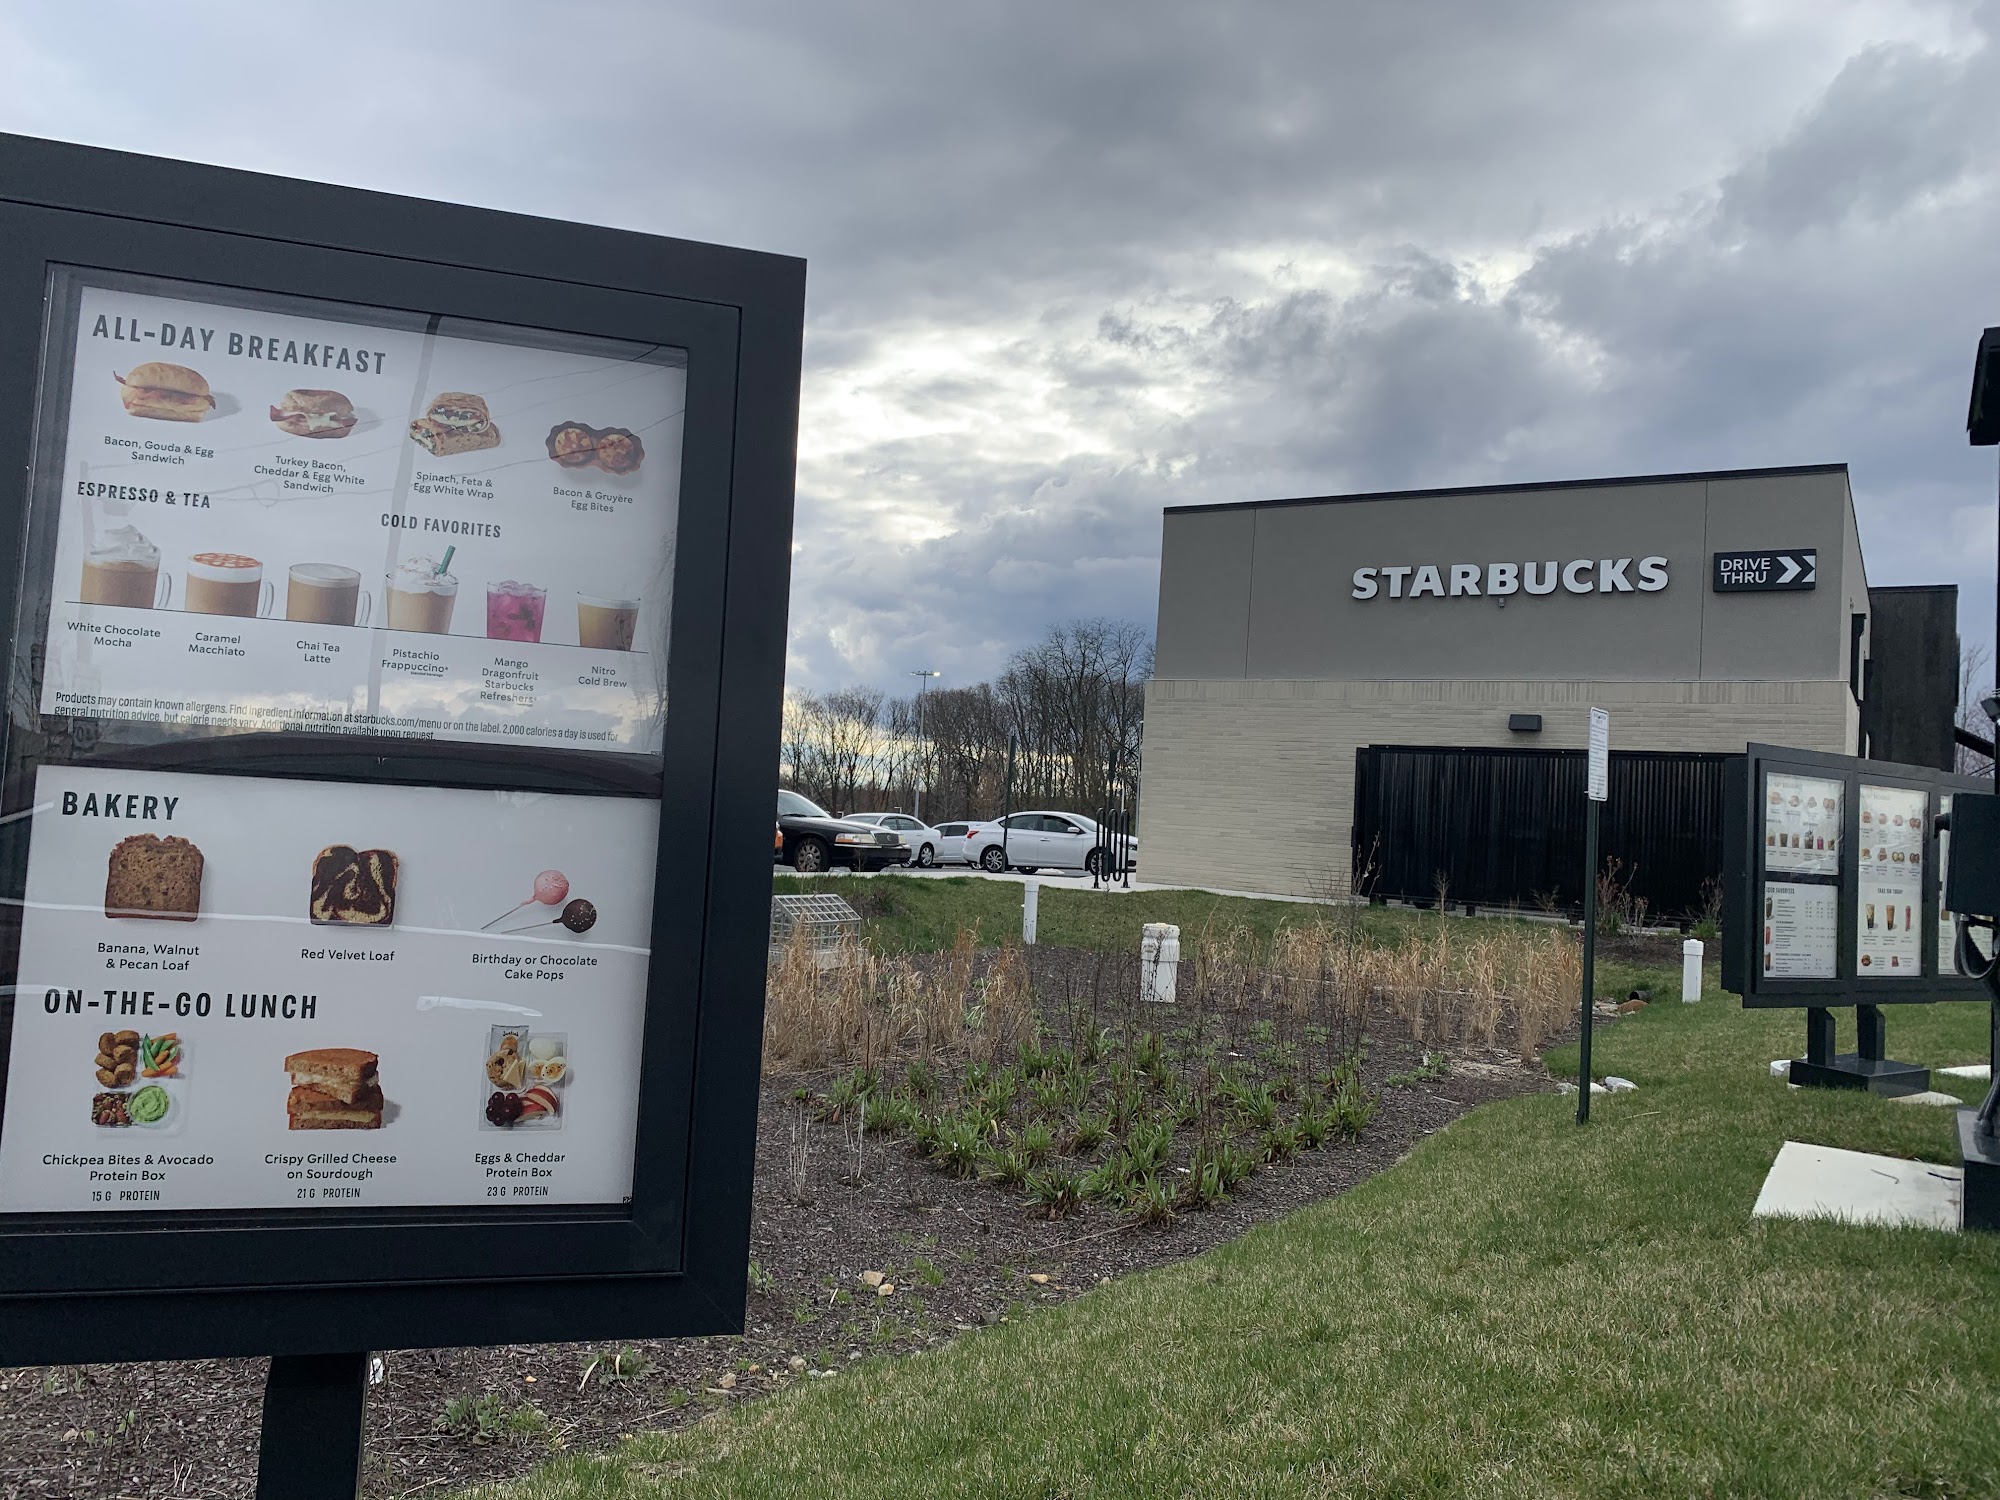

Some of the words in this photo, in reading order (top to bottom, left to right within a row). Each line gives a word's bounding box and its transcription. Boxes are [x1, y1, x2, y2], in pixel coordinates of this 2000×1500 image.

[92, 314, 215, 351] ALL-DAY
[228, 332, 386, 374] BREAKFAST
[104, 436, 141, 450] Bacon,
[144, 440, 181, 453] Gouda
[183, 445, 194, 455] &
[196, 446, 214, 459] Egg
[131, 450, 185, 465] Sandwich
[275, 455, 309, 470] Turkey
[311, 458, 347, 473] Bacon,
[254, 465, 299, 478] Cheddar
[302, 470, 311, 479] &
[313, 470, 331, 484] Egg
[334, 472, 365, 485] White
[416, 472, 459, 485] Spinach,
[461, 476, 483, 487] Feta
[485, 479, 493, 488] &
[283, 480, 334, 494] Sandwich
[414, 482, 431, 494] Egg
[433, 484, 464, 496] White
[467, 488, 494, 500] Wrap
[553, 487, 583, 498] Bacon
[586, 490, 593, 499] &
[77, 481, 158, 503] ESPRESSO
[165, 491, 177, 504] &
[183, 493, 211, 509] TEA
[571, 500, 588, 512] Egg
[590, 502, 614, 513] Bites
[381, 514, 418, 530] COLD
[424, 518, 501, 538] FAVORITES
[1720, 557, 1771, 572] DRIVE
[1351, 556, 1669, 600] STARBUCKS
[1720, 570, 1767, 585] THRU
[67, 622, 102, 633] White
[104, 624, 161, 638] Chocolate
[94, 637, 132, 648] Mocha
[195, 632, 241, 644] Caramel
[188, 644, 245, 657] Macchiato
[296, 640, 321, 651] Chai
[323, 642, 340, 653] Tea
[304, 653, 331, 664] Latte
[393, 648, 440, 661] Pistachio
[494, 658, 528, 669] Mango
[482, 668, 539, 681] Dragonfruit
[592, 665, 616, 677] Nitro
[485, 680, 534, 692] Starbucks
[578, 676, 600, 687] Cold
[602, 678, 627, 689] Brew
[55, 706, 88, 716] general
[90, 708, 129, 719] nutrition
[164, 712, 179, 723] but
[181, 714, 209, 725] calorie
[212, 716, 238, 727] needs
[261, 720, 302, 731] Additional
[304, 722, 341, 734] nutrition
[343, 726, 379, 736] available
[380, 730, 401, 738] upon
[56, 692, 96, 705] Products
[98, 697, 117, 708] may
[119, 697, 152, 709] contain
[155, 699, 184, 711] known
[186, 701, 227, 714] allergens.
[230, 704, 247, 715] Find
[250, 706, 292, 718] ingredient
[294, 709, 342, 722] information
[344, 714, 352, 722] at
[354, 714, 442, 729] starbucks.com/menu
[454, 722, 463, 730] on
[466, 722, 478, 732] the
[480, 722, 500, 733] label.
[503, 724, 525, 735] 2,000
[526, 727, 557, 738] calories
[558, 730, 563, 738] a
[564, 729, 579, 741] day
[580, 730, 587, 739] is
[588, 731, 606, 741] used
[608, 732, 618, 742] for
[61, 791, 179, 821] BAKERY
[98, 942, 150, 956] Banana,
[154, 944, 200, 956] Walnut
[301, 949, 325, 961] Red
[328, 950, 366, 961] Velvet
[370, 950, 395, 962] Loaf
[106, 959, 115, 969] &
[120, 959, 158, 970] Pecan
[162, 960, 190, 971] Loaf
[472, 954, 522, 967] Birthday
[525, 957, 537, 966] or
[540, 955, 598, 966] Chocolate
[504, 968, 533, 980] Cake
[536, 970, 564, 982] Pops
[44, 989, 212, 1016] ON-THE-GO
[225, 993, 317, 1019] LUNCH
[42, 1154, 104, 1167] Chickpea
[108, 1154, 141, 1165] Bites
[144, 1154, 154, 1165] &
[158, 1154, 214, 1165] Avocado
[265, 1154, 304, 1167] Crispy
[307, 1152, 349, 1165] Grilled
[352, 1153, 397, 1165] Cheese
[475, 1152, 501, 1165] Eggs
[504, 1153, 513, 1163] &
[514, 1152, 565, 1164] Cheddar
[90, 1170, 137, 1181] Protein
[142, 1170, 166, 1181] Box
[287, 1170, 303, 1179] on
[306, 1168, 373, 1181] Sourdough
[486, 1167, 528, 1178] Protein
[532, 1167, 553, 1178] Box
[92, 1191, 102, 1201] 15
[105, 1191, 111, 1201] G
[120, 1190, 160, 1201] PROTEIN
[297, 1188, 307, 1199] 21
[309, 1188, 316, 1199] G
[323, 1188, 361, 1199] PROTEIN
[487, 1186, 498, 1197] 23
[500, 1186, 506, 1197] G
[513, 1186, 549, 1197] PROTEIN
